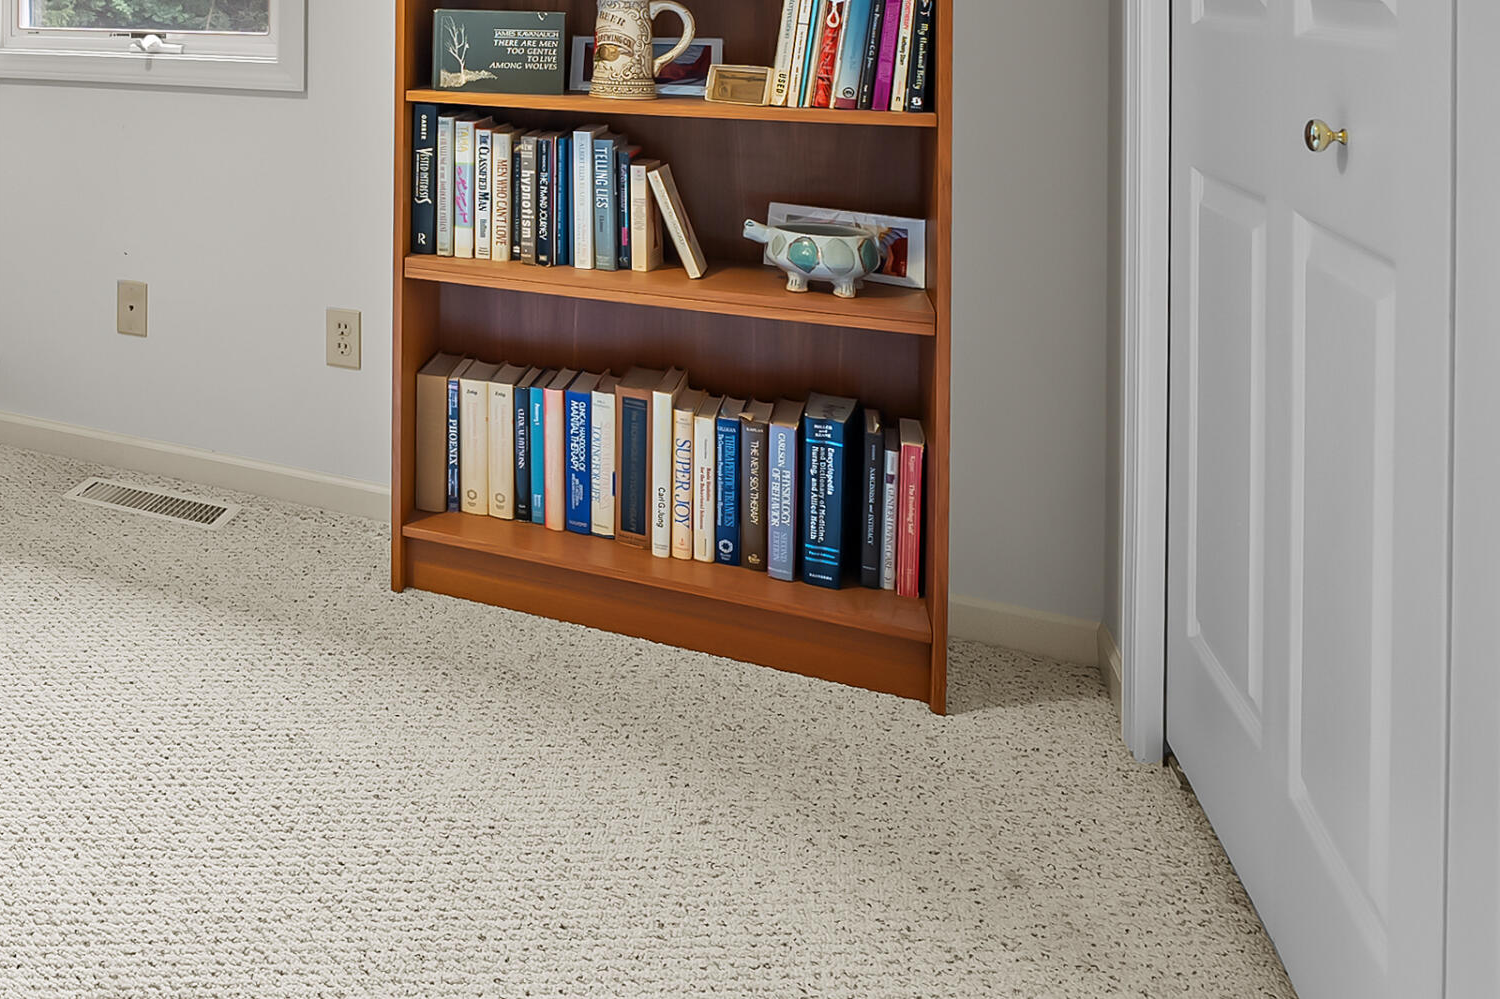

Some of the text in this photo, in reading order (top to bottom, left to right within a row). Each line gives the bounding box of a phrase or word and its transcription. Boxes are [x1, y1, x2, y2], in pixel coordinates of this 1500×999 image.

[538, 40, 558, 48] MEN
[918, 23, 928, 35] My
[489, 61, 558, 70] AMONG WOLVES
[507, 47, 557, 56] TOO GENTLE
[916, 37, 927, 68] Husband
[775, 73, 786, 93] USED
[478, 146, 489, 189] CLASSIFIED
[496, 160, 507, 176] MEN
[595, 147, 608, 208] TELLING LIES
[478, 191, 489, 211] MAN
[496, 179, 507, 198] WHO
[521, 170, 534, 238] hypnotism
[495, 225, 506, 245] LOVE
[449, 418, 457, 465] PHOENIX
[777, 432, 785, 467] CARLSON
[674, 437, 691, 495] SUPER
[809, 445, 818, 476] Nursing,
[826, 447, 834, 495] Encyclopedia
[657, 486, 665, 502] Carl
[750, 440, 758, 525] THE NEW SEX THERAPY
[817, 461, 825, 499] Dictionary
[673, 493, 690, 529] JOY
[770, 467, 779, 527] OF BEHAVIOR
[780, 468, 790, 526] PHYSIOLOGY
[656, 509, 665, 528] Jung
[809, 514, 817, 540] Health
